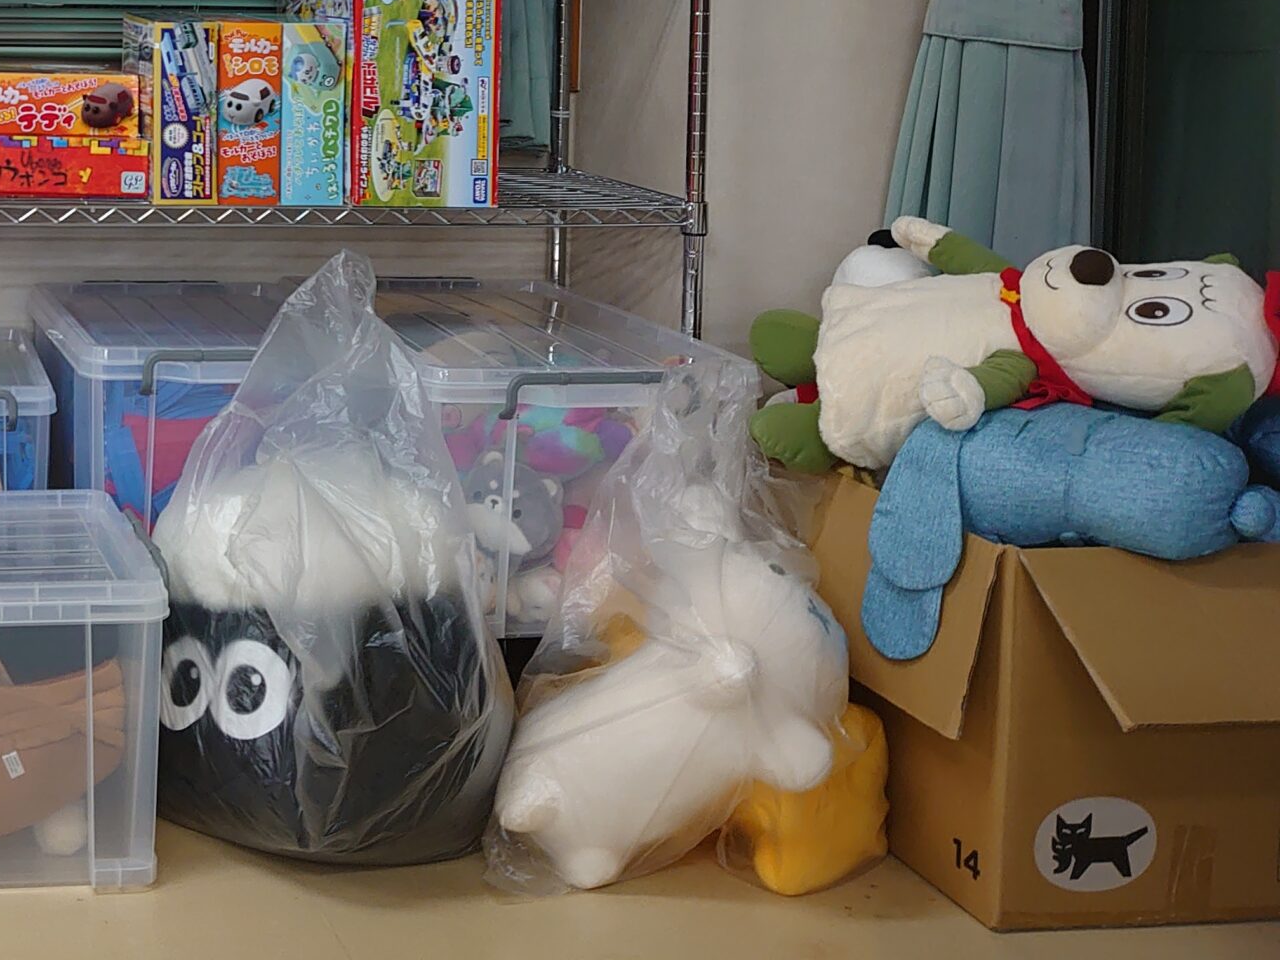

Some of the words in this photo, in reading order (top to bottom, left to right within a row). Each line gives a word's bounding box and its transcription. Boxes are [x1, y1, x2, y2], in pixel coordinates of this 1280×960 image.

[229, 38, 279, 54] モルカー
[16, 103, 76, 132] テディ
[952, 837, 981, 881] 14
